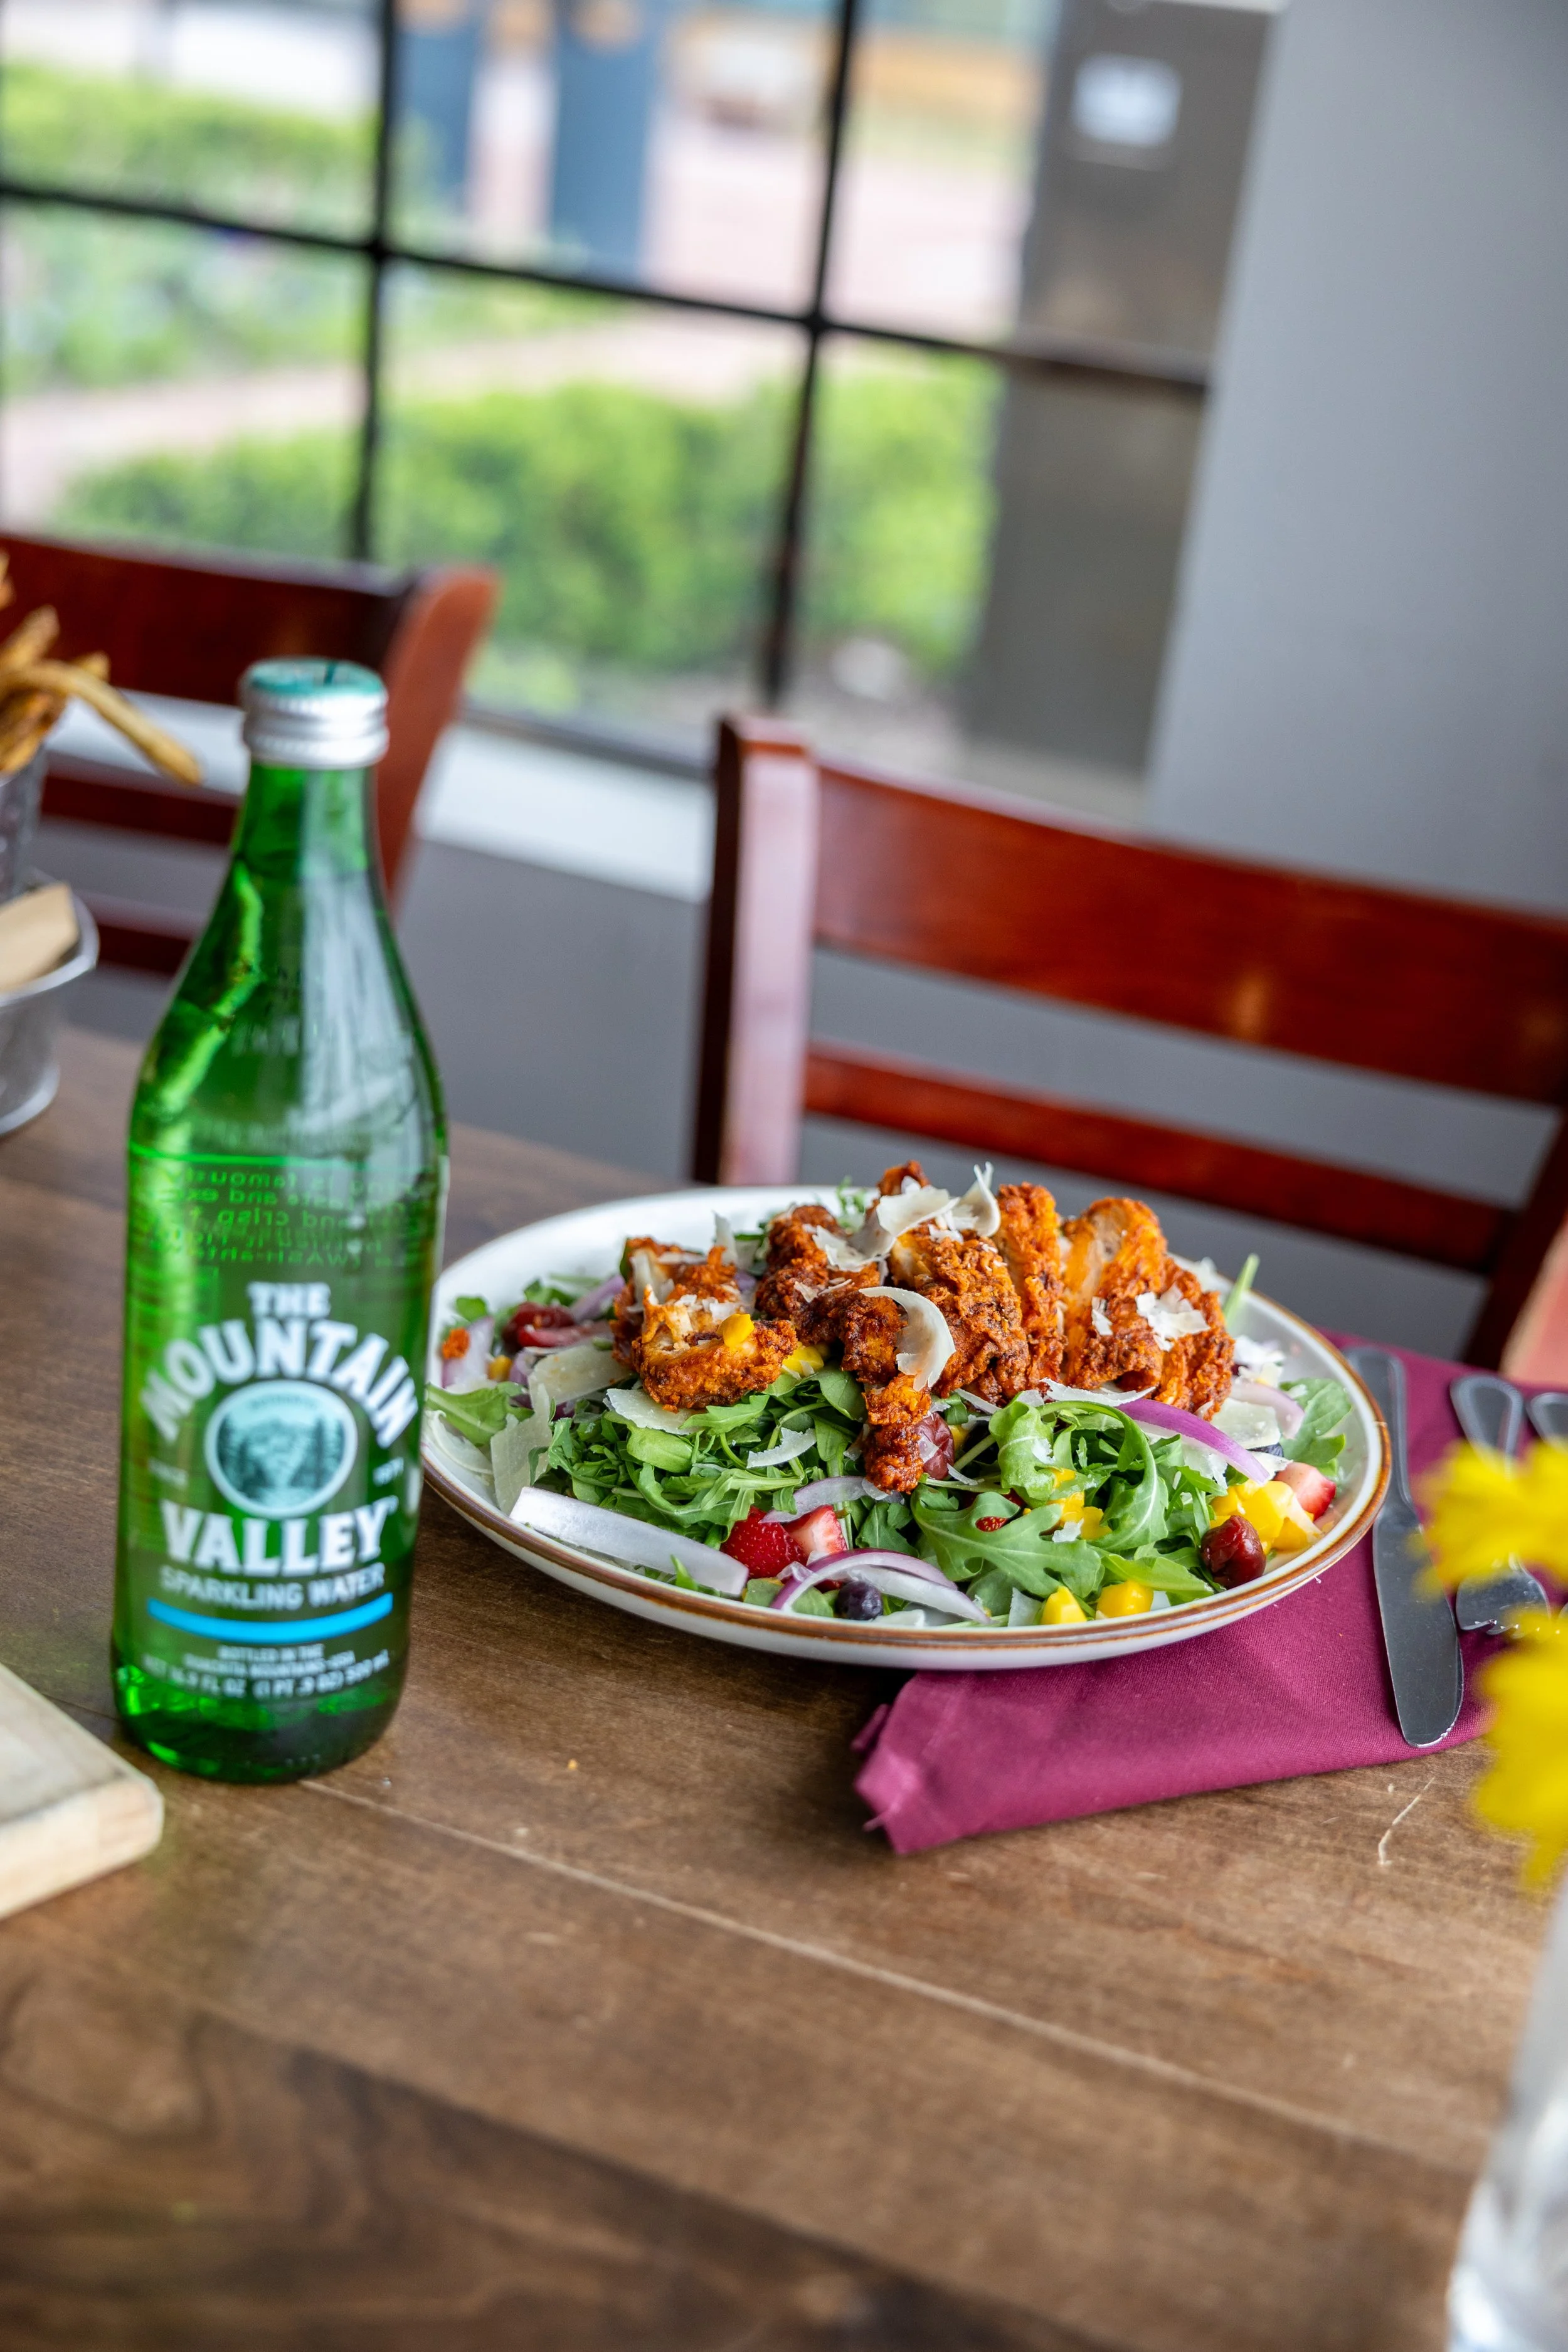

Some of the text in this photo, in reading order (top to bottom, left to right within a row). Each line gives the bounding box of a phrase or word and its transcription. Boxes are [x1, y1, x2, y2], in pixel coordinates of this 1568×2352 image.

[248, 1281, 331, 1316] THE
[139, 1318, 418, 1448] MOUNTAIN
[161, 1498, 390, 1576] VALLEY
[159, 1562, 385, 1611] SPARKLING WATER
